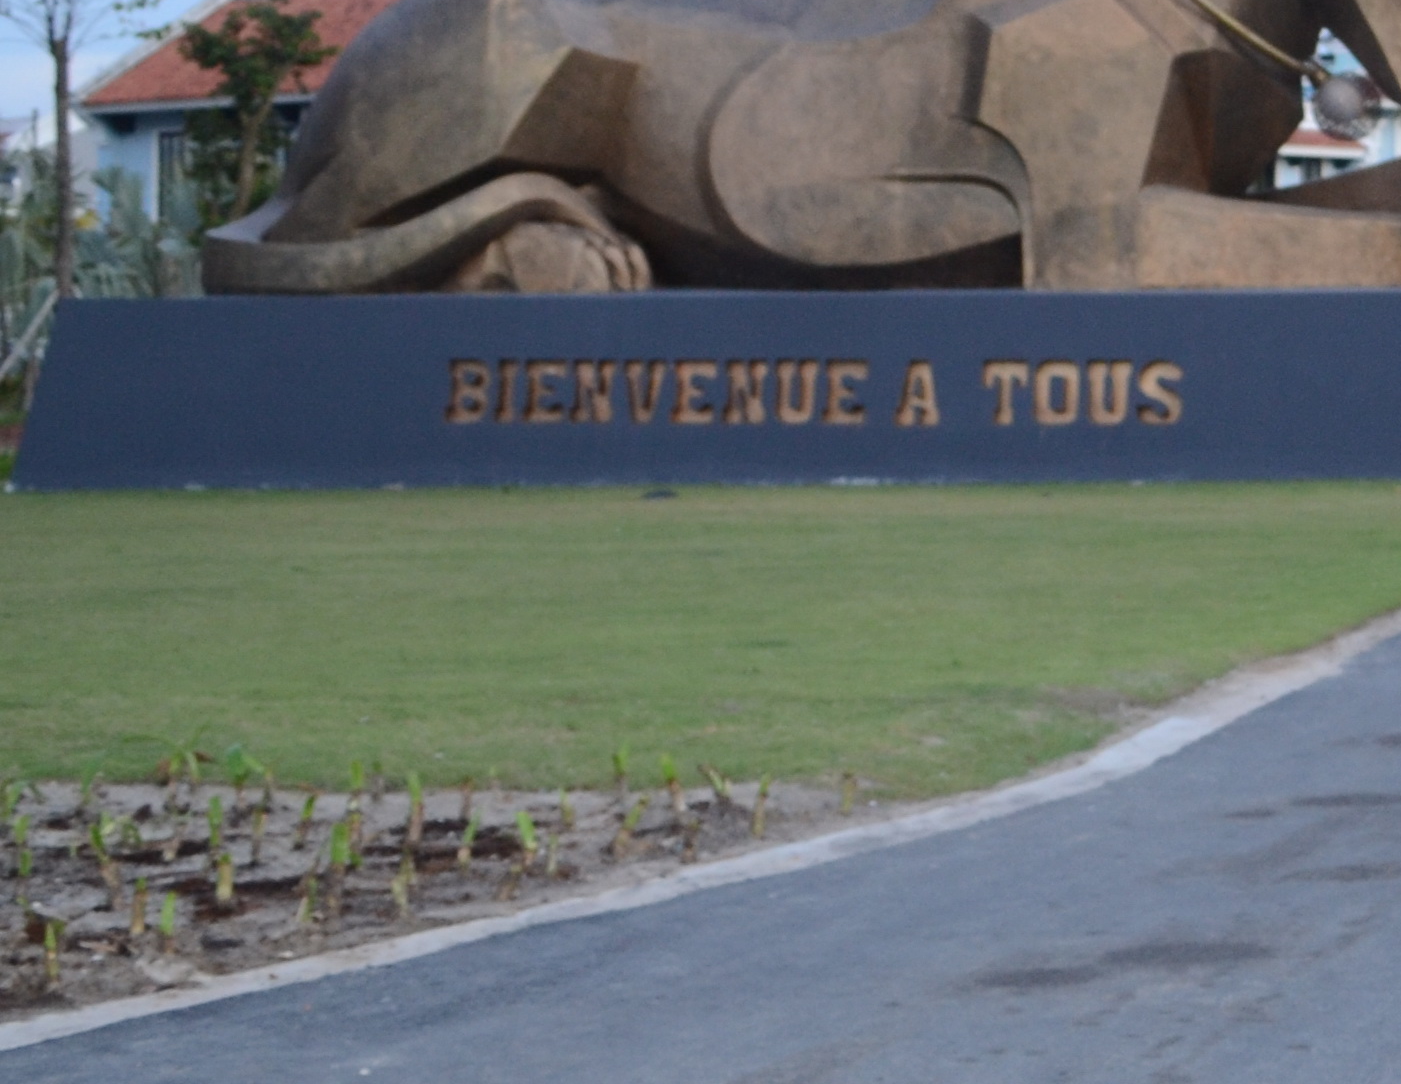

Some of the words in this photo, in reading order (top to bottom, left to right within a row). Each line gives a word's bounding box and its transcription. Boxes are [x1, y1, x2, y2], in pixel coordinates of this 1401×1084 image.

[445, 358, 869, 425] BIENVENUE
[895, 357, 941, 427] A
[983, 357, 1184, 426] TOUS
